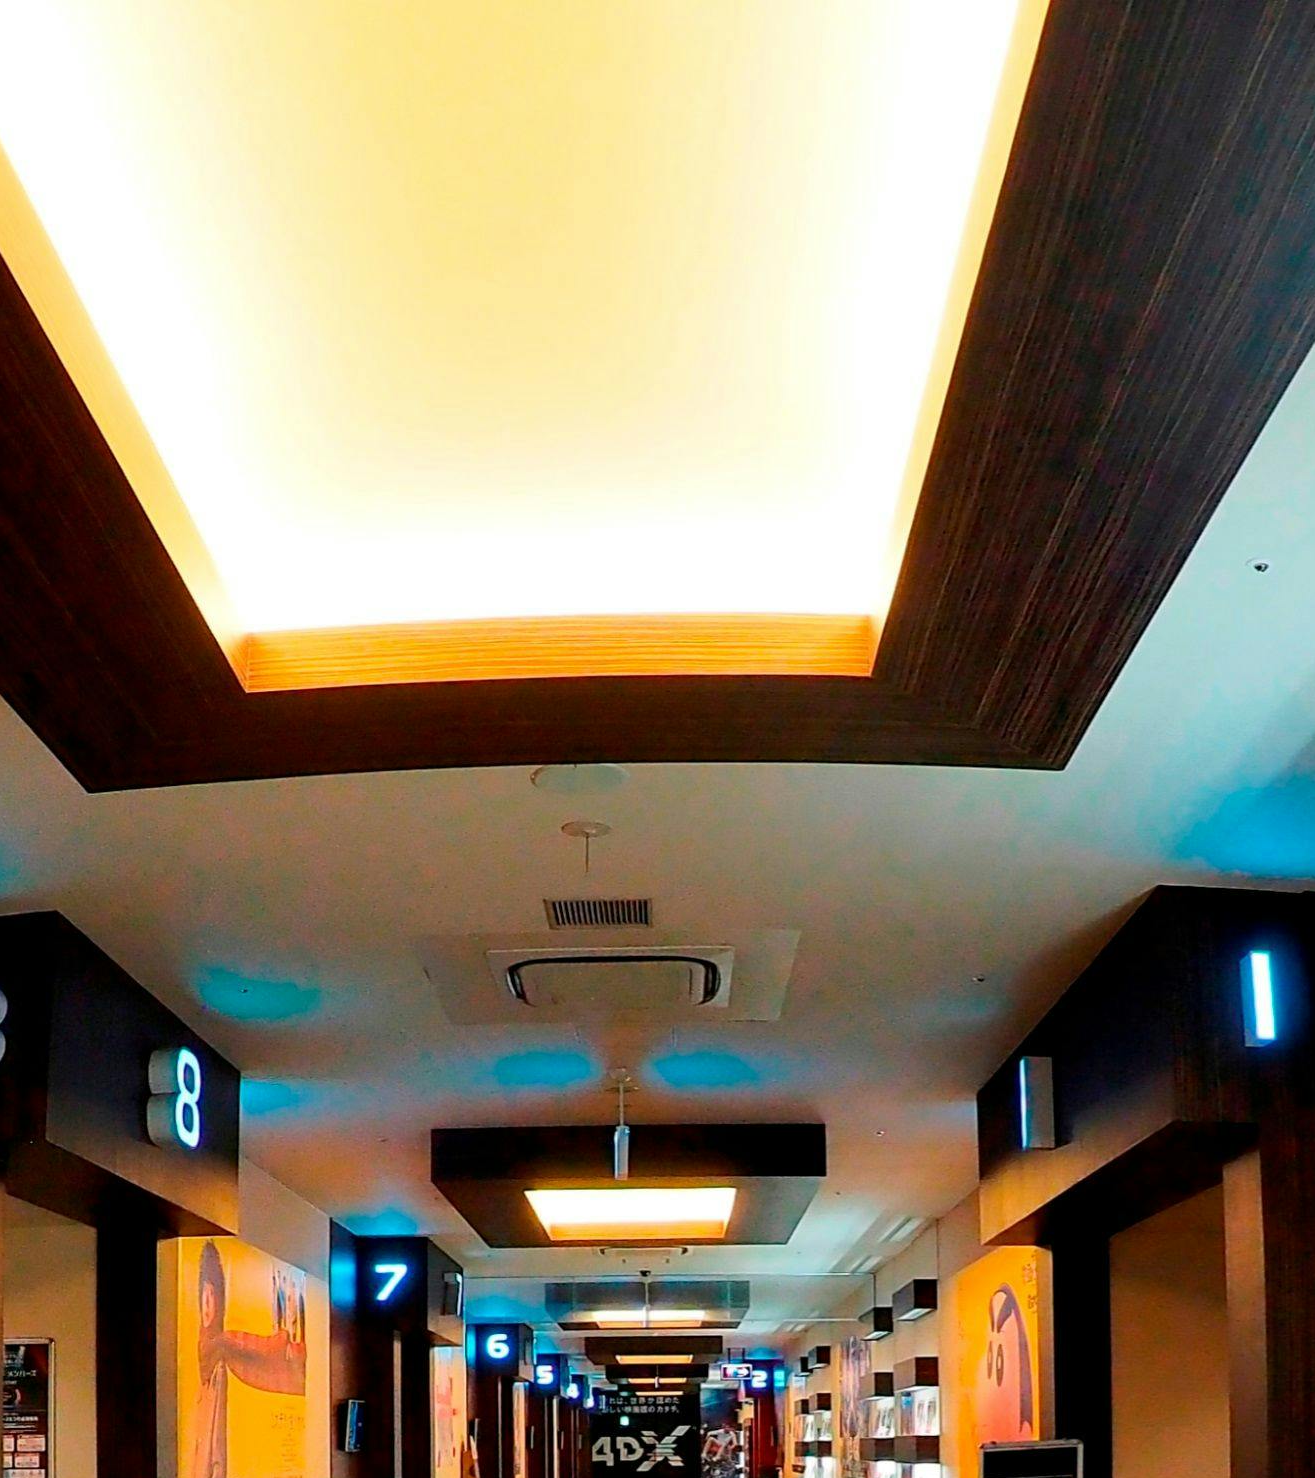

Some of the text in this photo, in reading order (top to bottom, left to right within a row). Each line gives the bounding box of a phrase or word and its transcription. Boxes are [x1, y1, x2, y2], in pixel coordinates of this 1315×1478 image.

[174, 1046, 202, 1148] 8
[374, 1264, 407, 1301] 7
[487, 1333, 510, 1359] 6
[536, 1364, 555, 1385] 5
[751, 1370, 768, 1389] 2
[592, 1425, 691, 1472] 4DX
